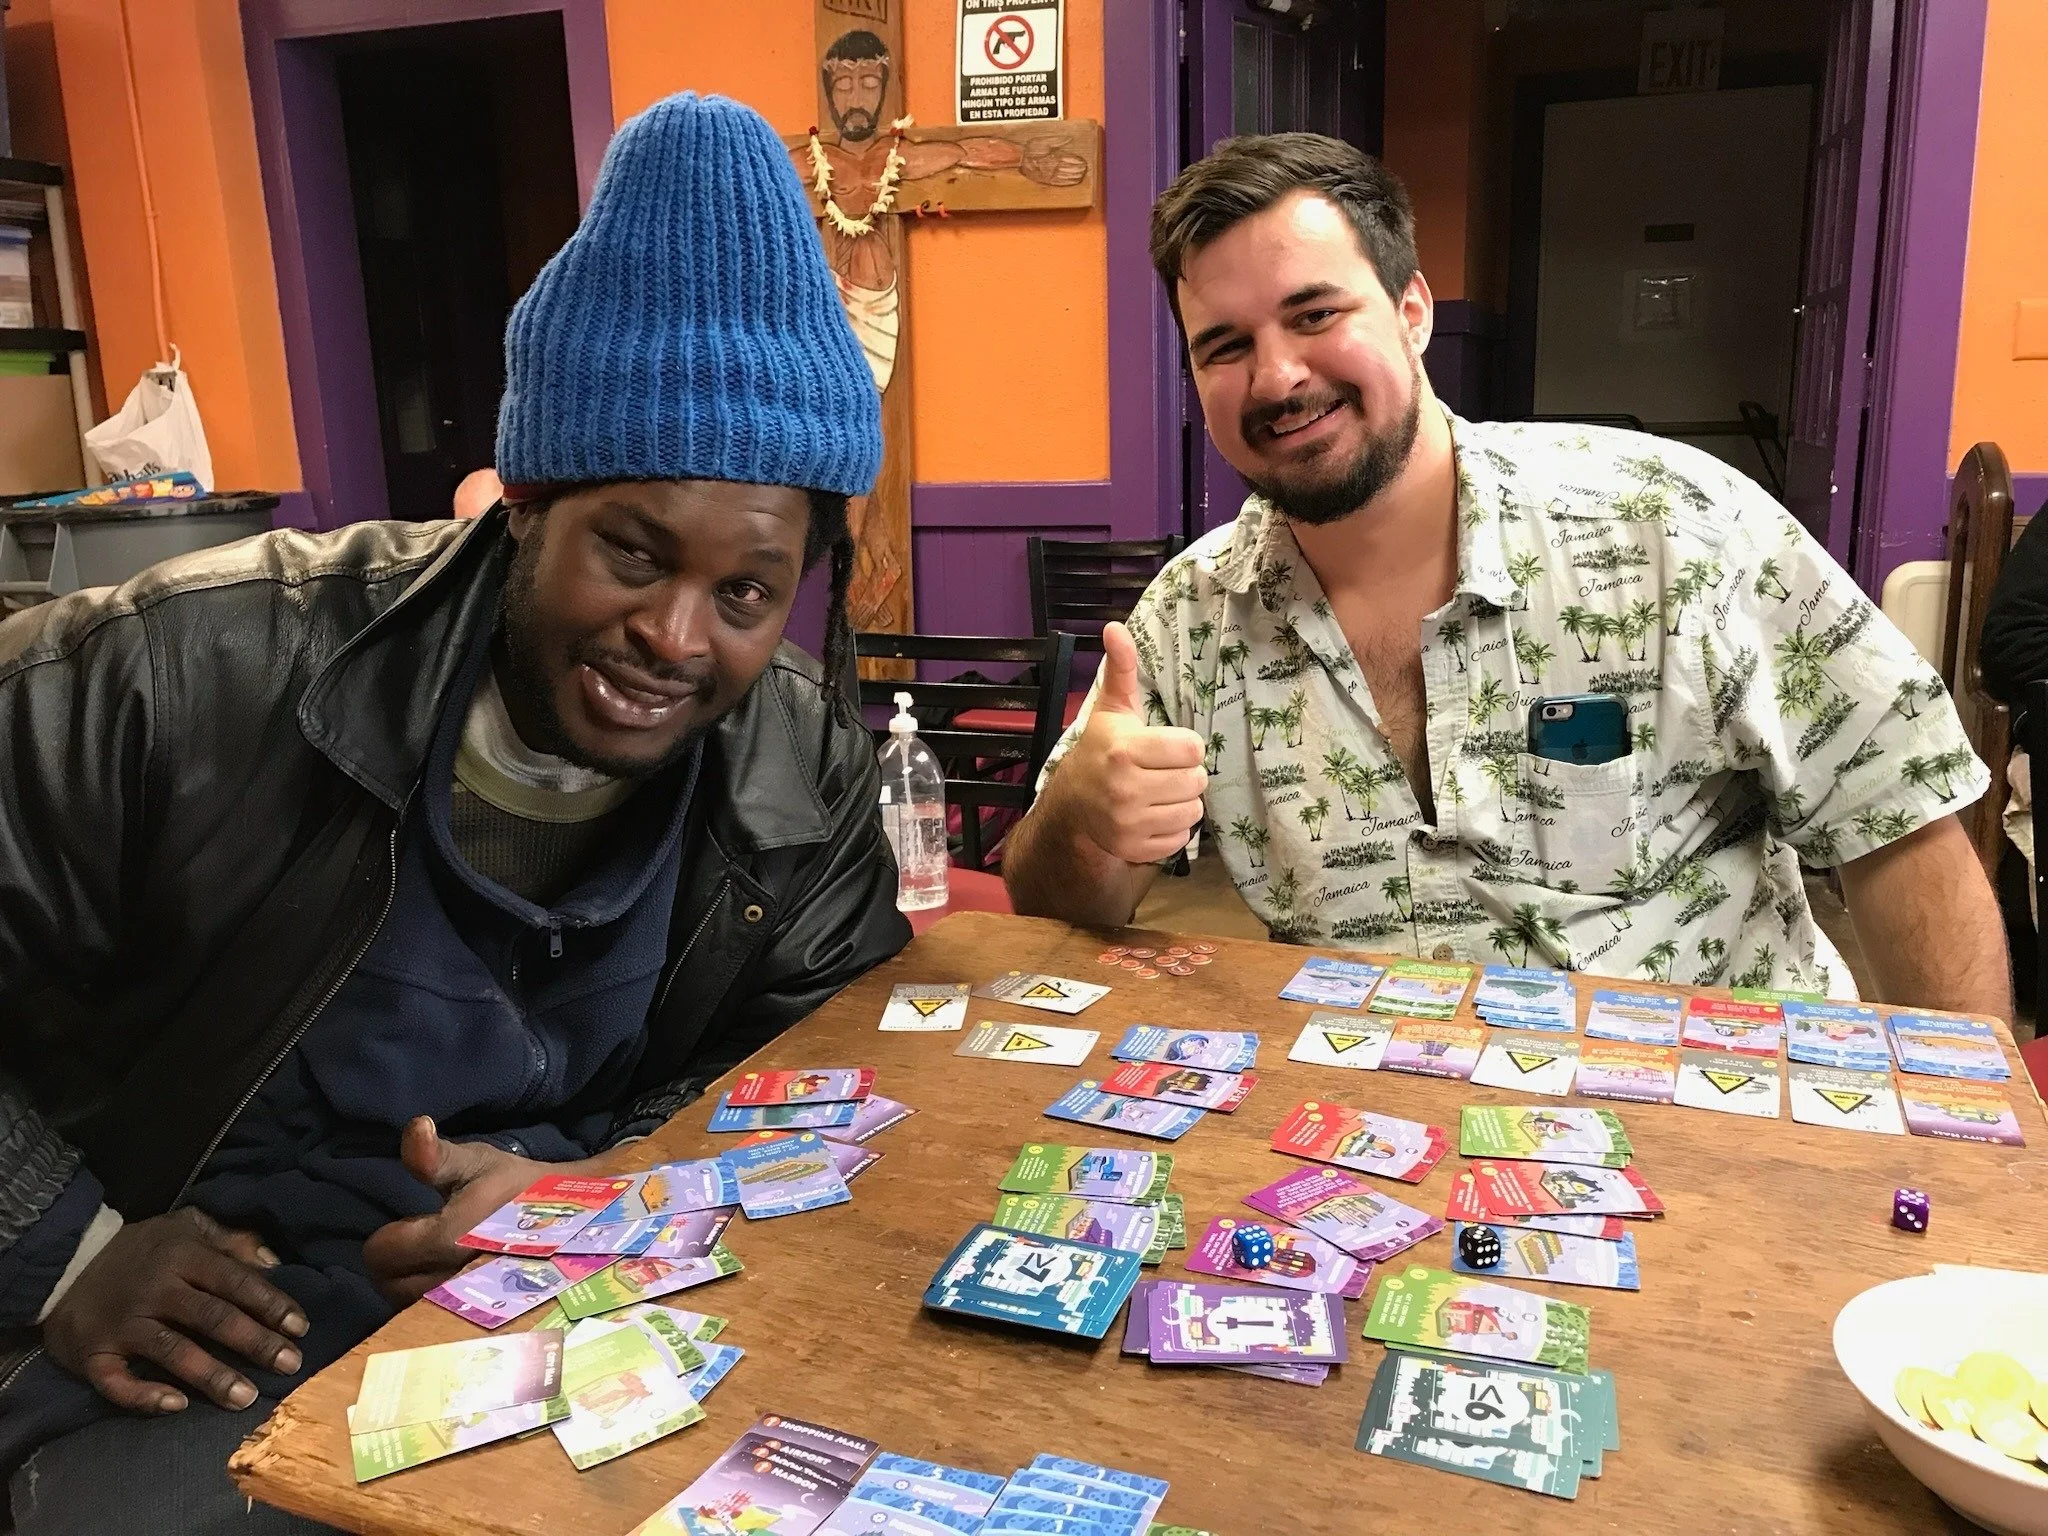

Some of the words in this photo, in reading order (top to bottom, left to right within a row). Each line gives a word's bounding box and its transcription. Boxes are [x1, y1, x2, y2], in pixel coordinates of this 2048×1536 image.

[1649, 40, 1713, 88] EXIT
[970, 75, 1013, 86] PROHIBIDO
[1015, 74, 1047, 84] PORTAR
[970, 87, 998, 97] ARMAS
[1000, 86, 1010, 96] DE
[1011, 85, 1038, 95] FUEGO
[1040, 85, 1047, 94] O
[994, 97, 1014, 107] TIPO
[1015, 96, 1026, 106] DE
[1027, 95, 1056, 105] ARMAS
[969, 110, 981, 119] EN
[982, 109, 1003, 119] ESTA
[1003, 107, 1049, 118] PROPIEDAD
[1551, 524, 1614, 548] Jamaica
[1579, 573, 1643, 597] Jamaica
[1716, 567, 1746, 631] Jamaica
[1362, 810, 1423, 837] Jamaica
[1510, 849, 1573, 873] Jamaica
[1314, 879, 1371, 908] Jamaica
[1577, 933, 1622, 972] Jamaica
[703, 1222, 723, 1245] HARBOR
[660, 1330, 687, 1350] 2-3
[545, 1350, 557, 1367] CITY
[543, 1366, 554, 1387] HALL
[778, 1420, 834, 1442] SHOPPING
[834, 1436, 867, 1452] MALL
[767, 1453, 803, 1472] MOON
[779, 1445, 832, 1466] AIRPORT
[771, 1466, 818, 1491] HARBOR
[932, 1467, 943, 1479] 5
[1096, 1467, 1106, 1480] 1
[1076, 1484, 1086, 1496] 1
[912, 1500, 925, 1515] 5
[1066, 1503, 1075, 1515] 1
[1054, 1519, 1064, 1532] 1
